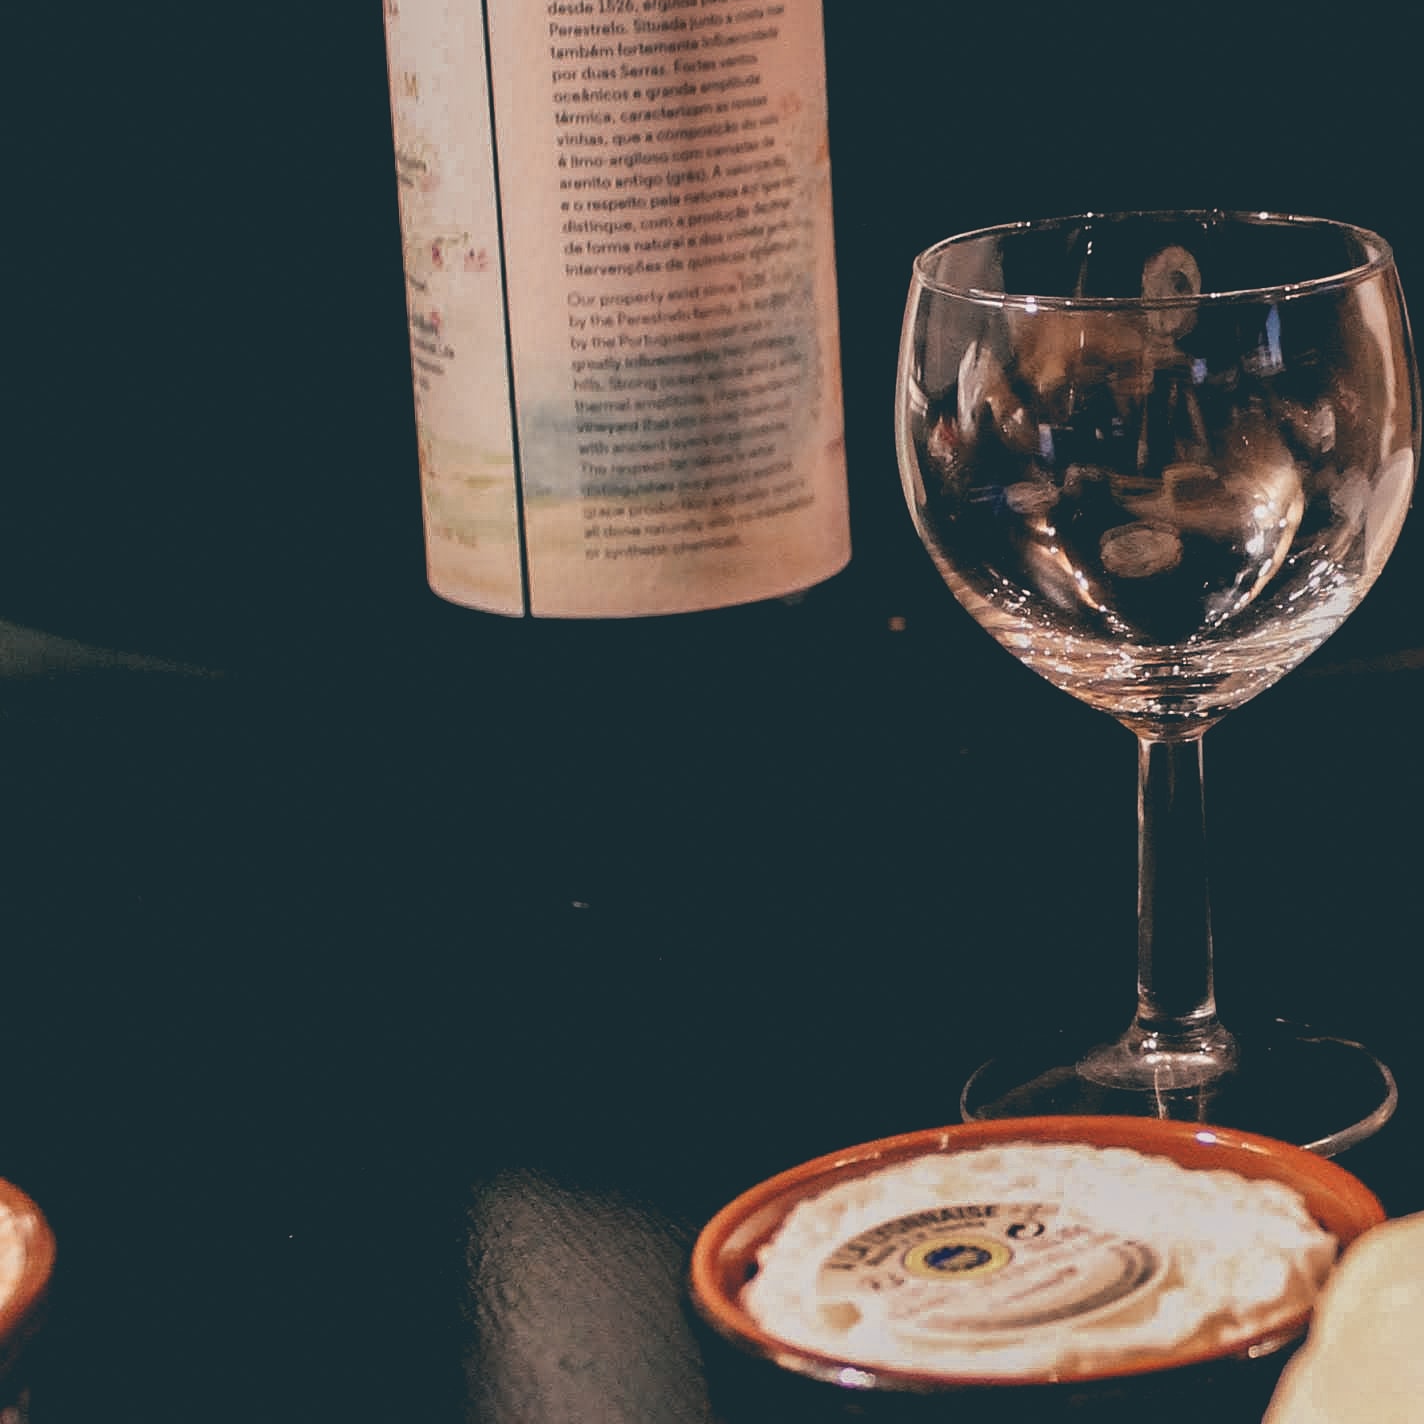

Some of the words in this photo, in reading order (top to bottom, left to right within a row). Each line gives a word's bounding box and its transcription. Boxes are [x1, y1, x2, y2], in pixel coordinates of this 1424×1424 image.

[548, 0, 594, 16] desde
[633, 16, 687, 34] Situada
[551, 44, 613, 60] também
[617, 38, 699, 58] fortemente
[552, 69, 577, 84] por
[581, 65, 617, 80] duas
[552, 87, 629, 104] oceânicos
[633, 89, 642, 100] e
[645, 81, 698, 102] grande
[554, 110, 617, 126] térmica,
[620, 100, 714, 124] caracterizam
[555, 132, 609, 148] vinhas,
[612, 131, 642, 149] que
[559, 175, 613, 191] arenito
[615, 170, 664, 189] antigo
[560, 199, 570, 212] e
[573, 200, 584, 212] o
[586, 195, 648, 214] respeito
[650, 191, 682, 210] pela
[564, 240, 584, 256] de
[587, 239, 631, 256] forma
[634, 233, 687, 253] natural
[565, 259, 662, 278] intervenções
[665, 256, 684, 271] de
[567, 291, 595, 307] Our
[600, 287, 664, 308] property
[569, 311, 587, 331] by
[590, 310, 615, 327] the
[570, 334, 588, 351] by
[592, 333, 616, 350] the
[578, 441, 609, 456] with
